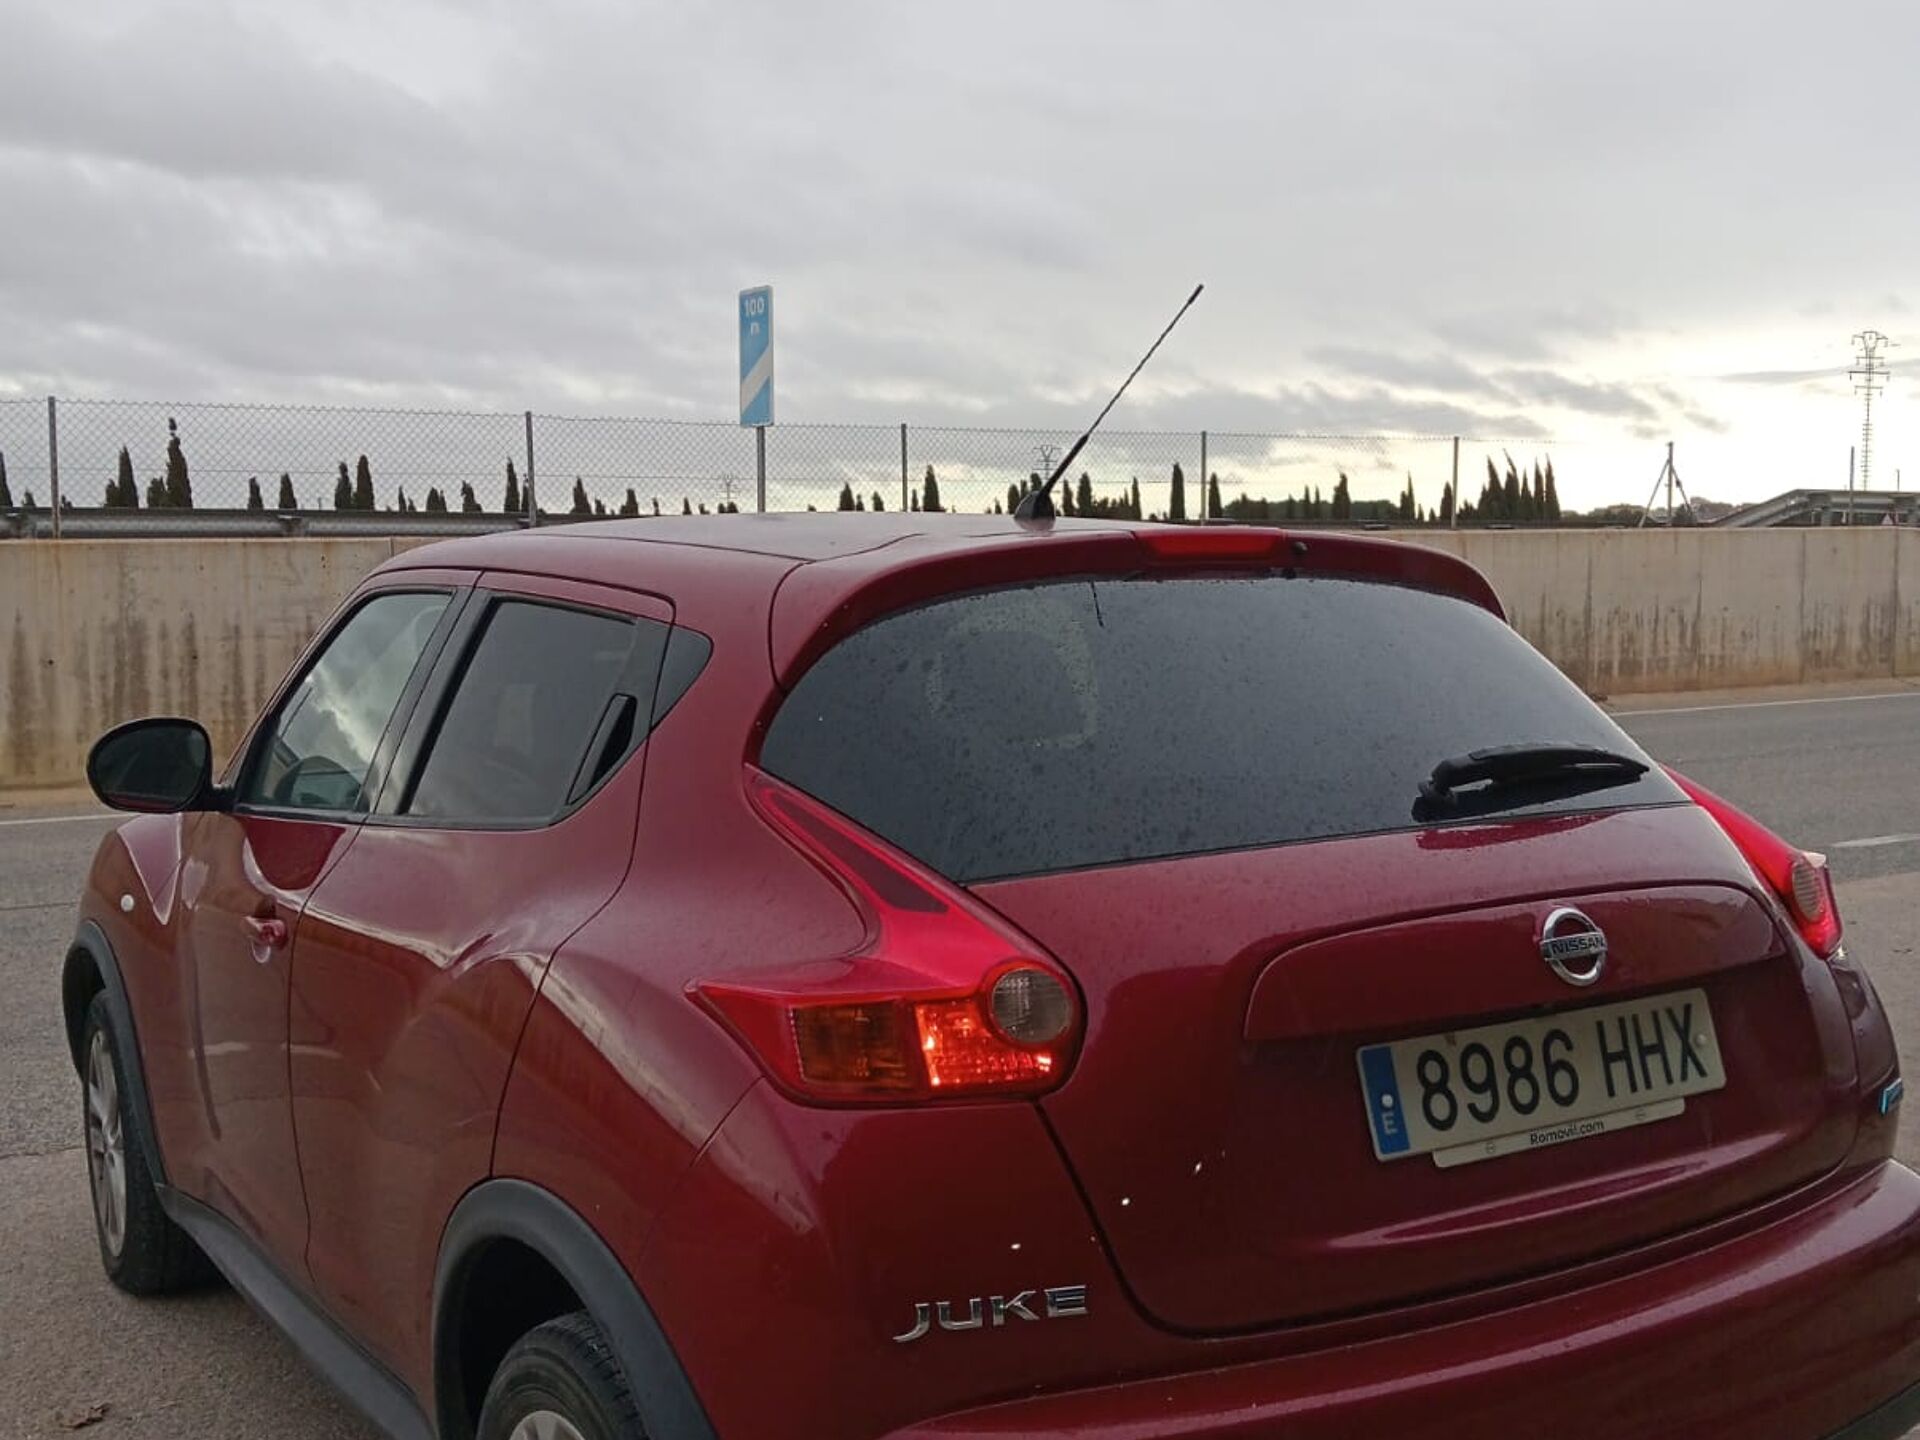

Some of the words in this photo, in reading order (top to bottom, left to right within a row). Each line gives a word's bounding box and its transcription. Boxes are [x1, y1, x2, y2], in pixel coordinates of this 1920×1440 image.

[744, 296, 765, 317] 100
[1551, 936, 1605, 954] NISSAN
[1416, 1028, 1580, 1132] 8986
[1596, 1002, 1708, 1098] HHX
[1381, 1111, 1399, 1135] E
[892, 1284, 1088, 1344] JUKE
